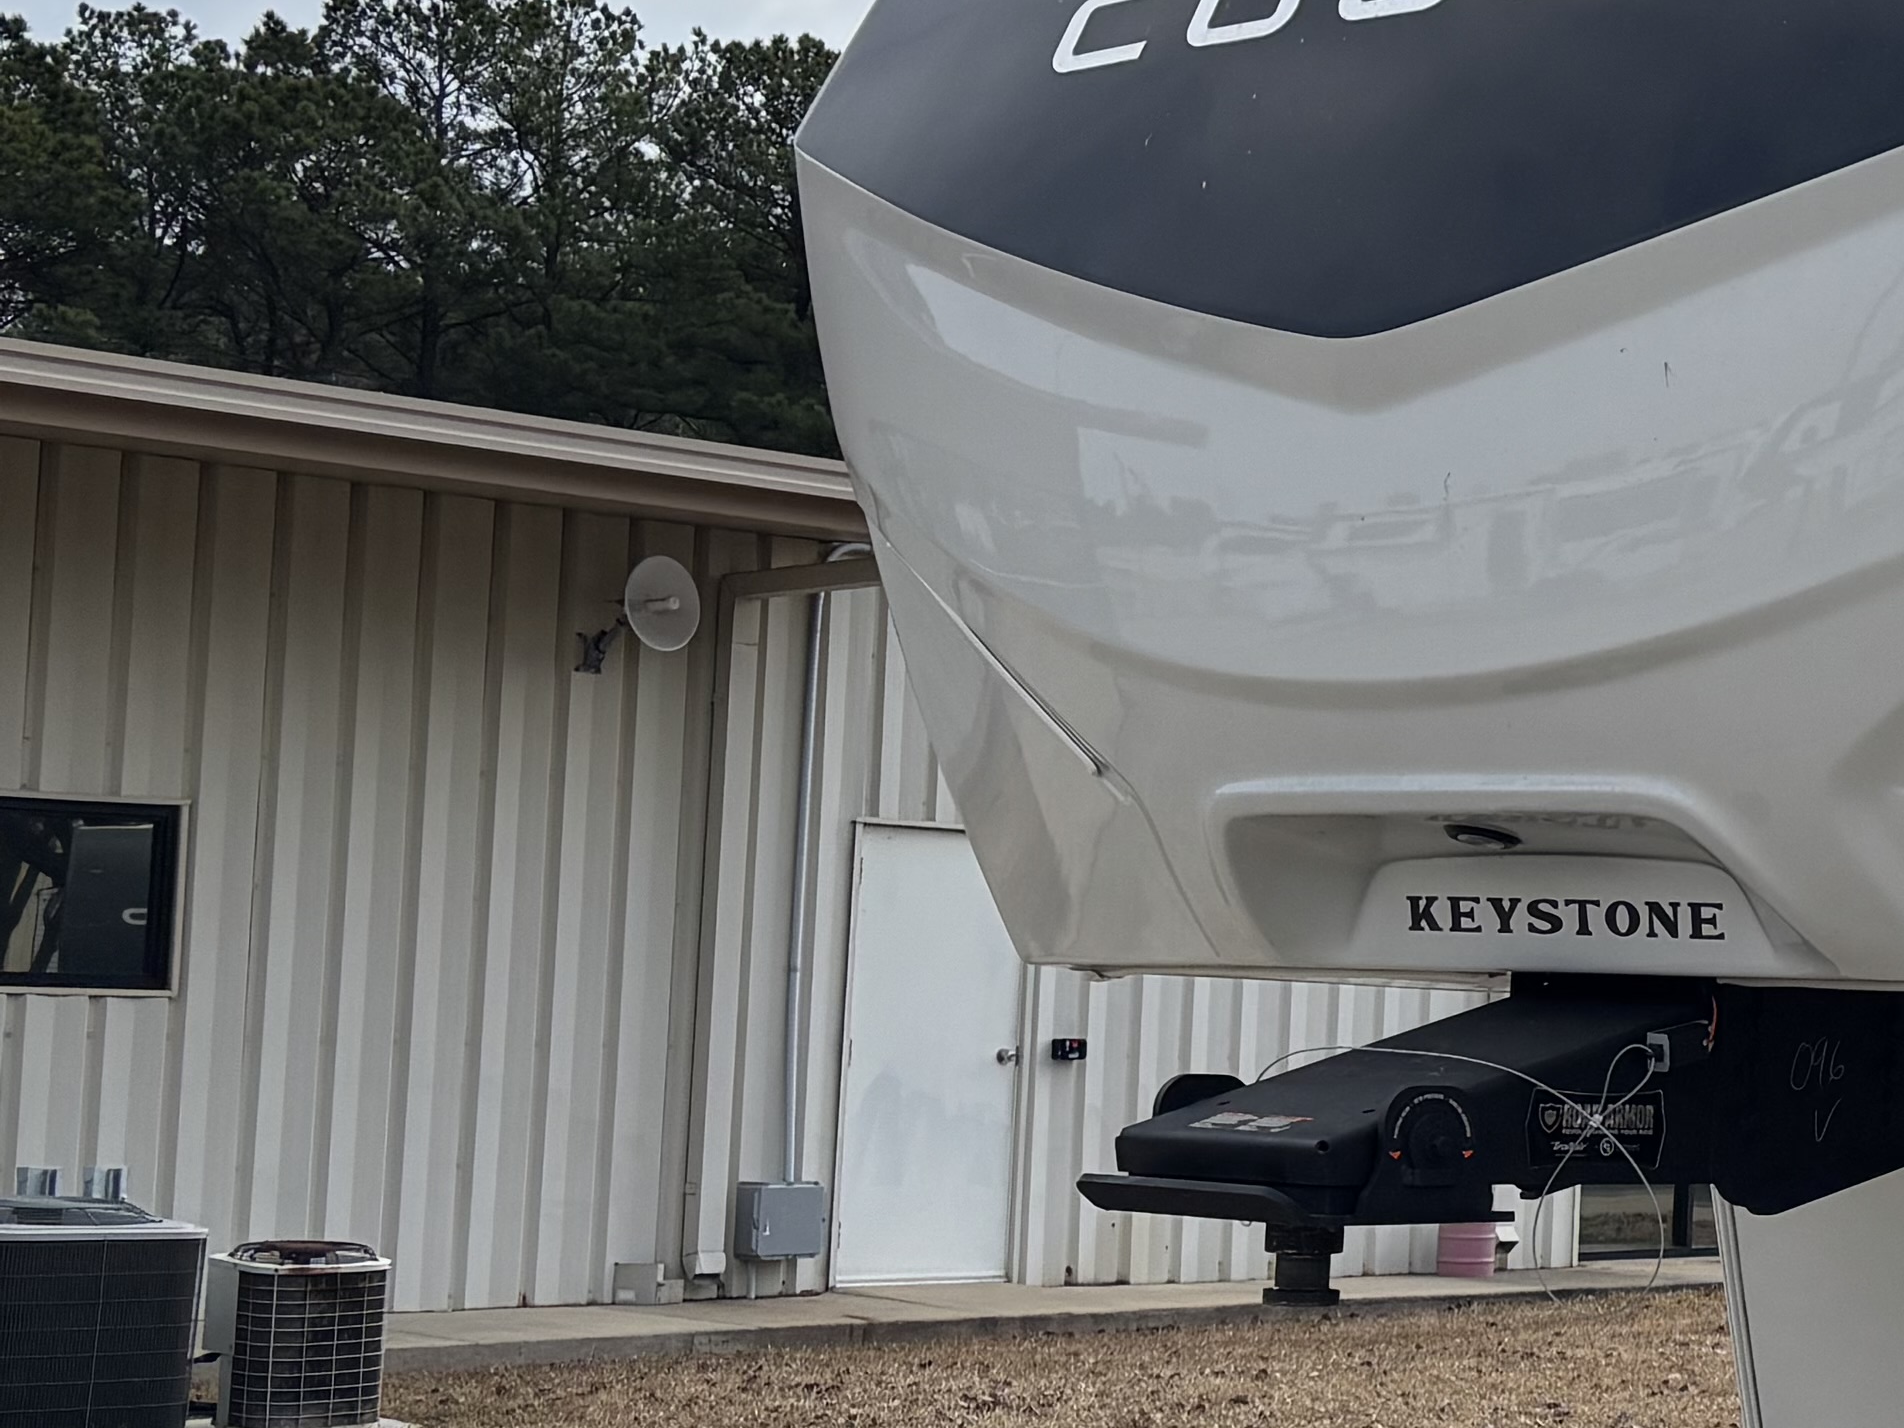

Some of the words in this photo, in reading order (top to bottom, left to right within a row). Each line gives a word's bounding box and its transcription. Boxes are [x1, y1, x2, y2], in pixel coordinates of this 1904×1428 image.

[1405, 895, 1726, 941] KEYSTONE
[1790, 1036, 1845, 1091] 096
[1604, 1103, 1655, 1129] ARMOR
